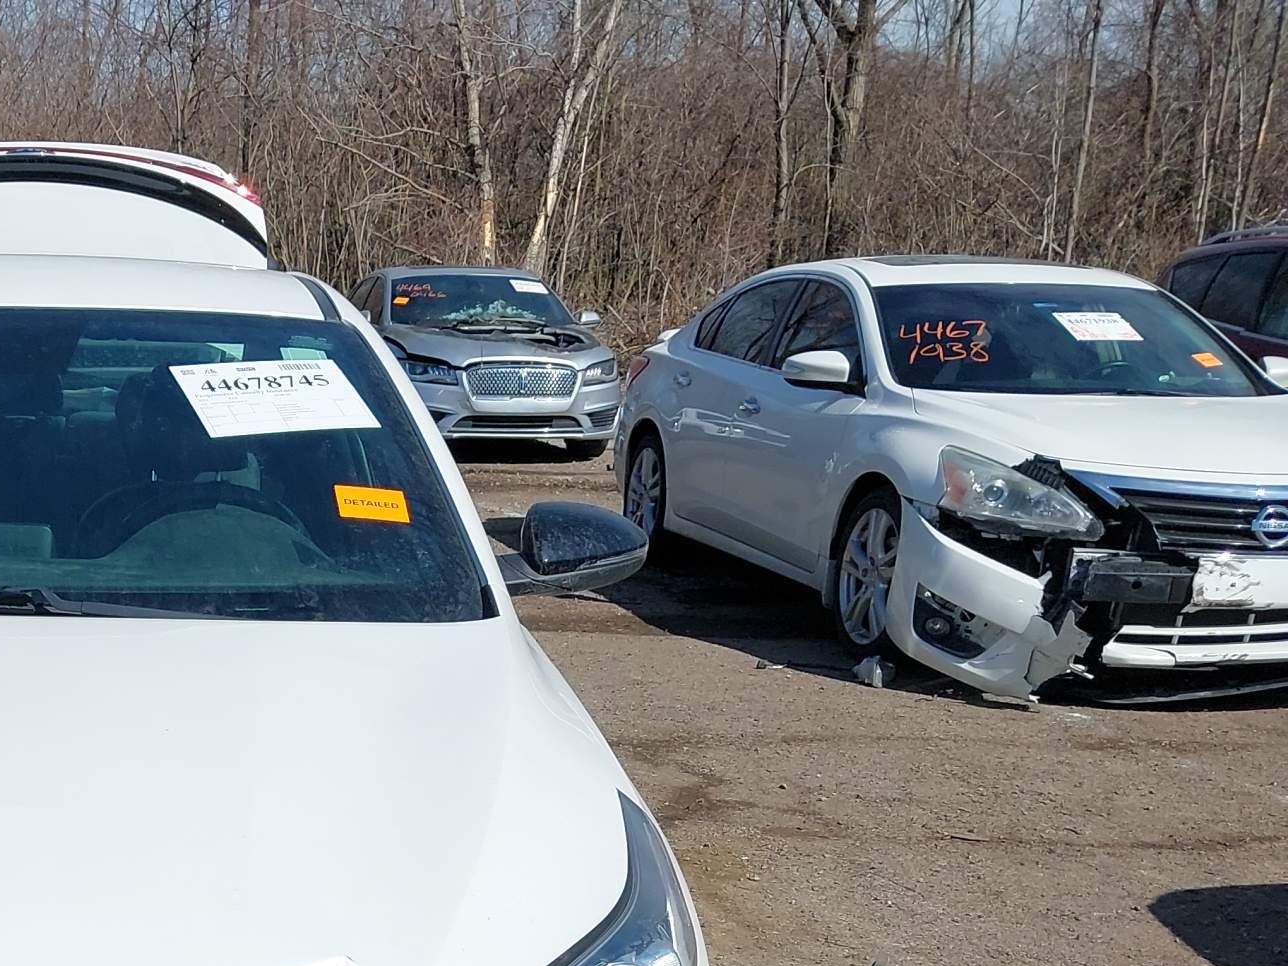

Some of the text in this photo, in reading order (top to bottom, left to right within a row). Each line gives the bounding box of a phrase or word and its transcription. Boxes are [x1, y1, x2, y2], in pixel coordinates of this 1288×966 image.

[899, 320, 986, 344] 4467
[909, 341, 989, 365] 1938
[200, 374, 330, 393] 44678745
[344, 498, 399, 509] DETAILED
